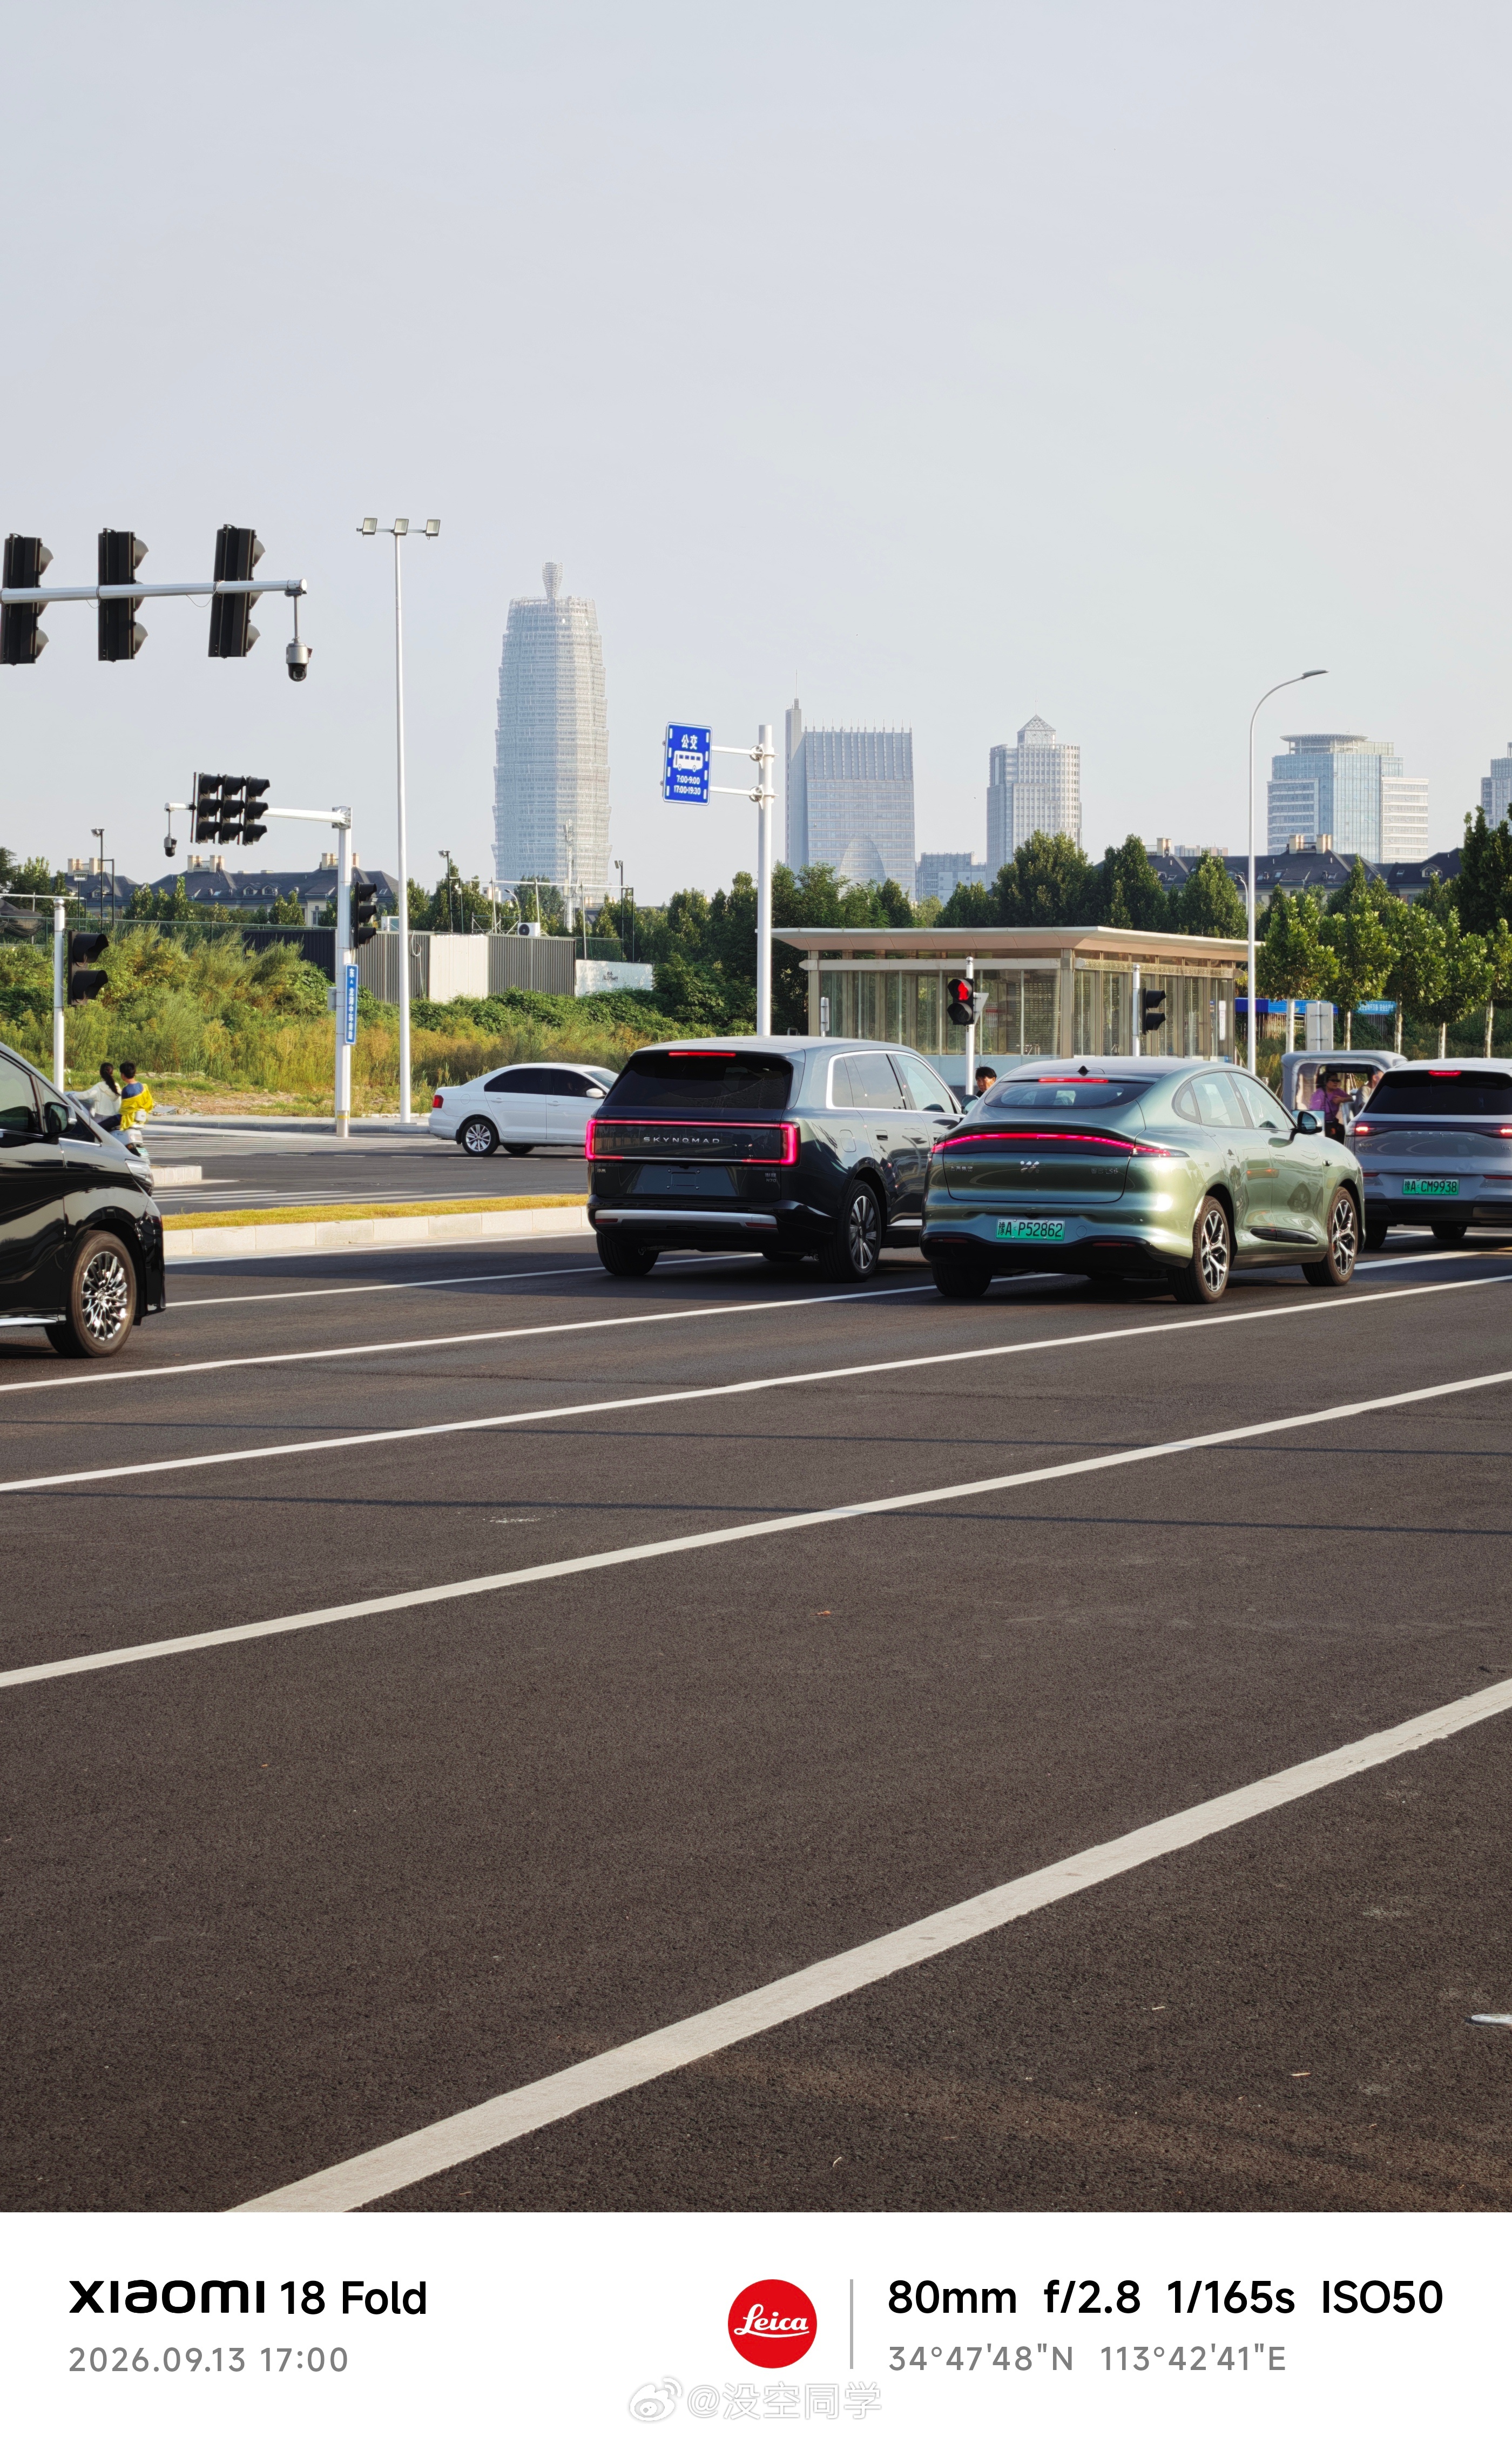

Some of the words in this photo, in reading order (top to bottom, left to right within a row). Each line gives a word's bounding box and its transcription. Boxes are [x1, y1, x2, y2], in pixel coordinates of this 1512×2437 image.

[681, 734, 698, 750] 公交
[676, 775, 700, 784] 7:00-9:00
[674, 785, 701, 795] 17:00-19:30
[349, 968, 354, 978] 东
[1421, 1181, 1457, 1193] CM9938
[1018, 1222, 1063, 1237] P52862
